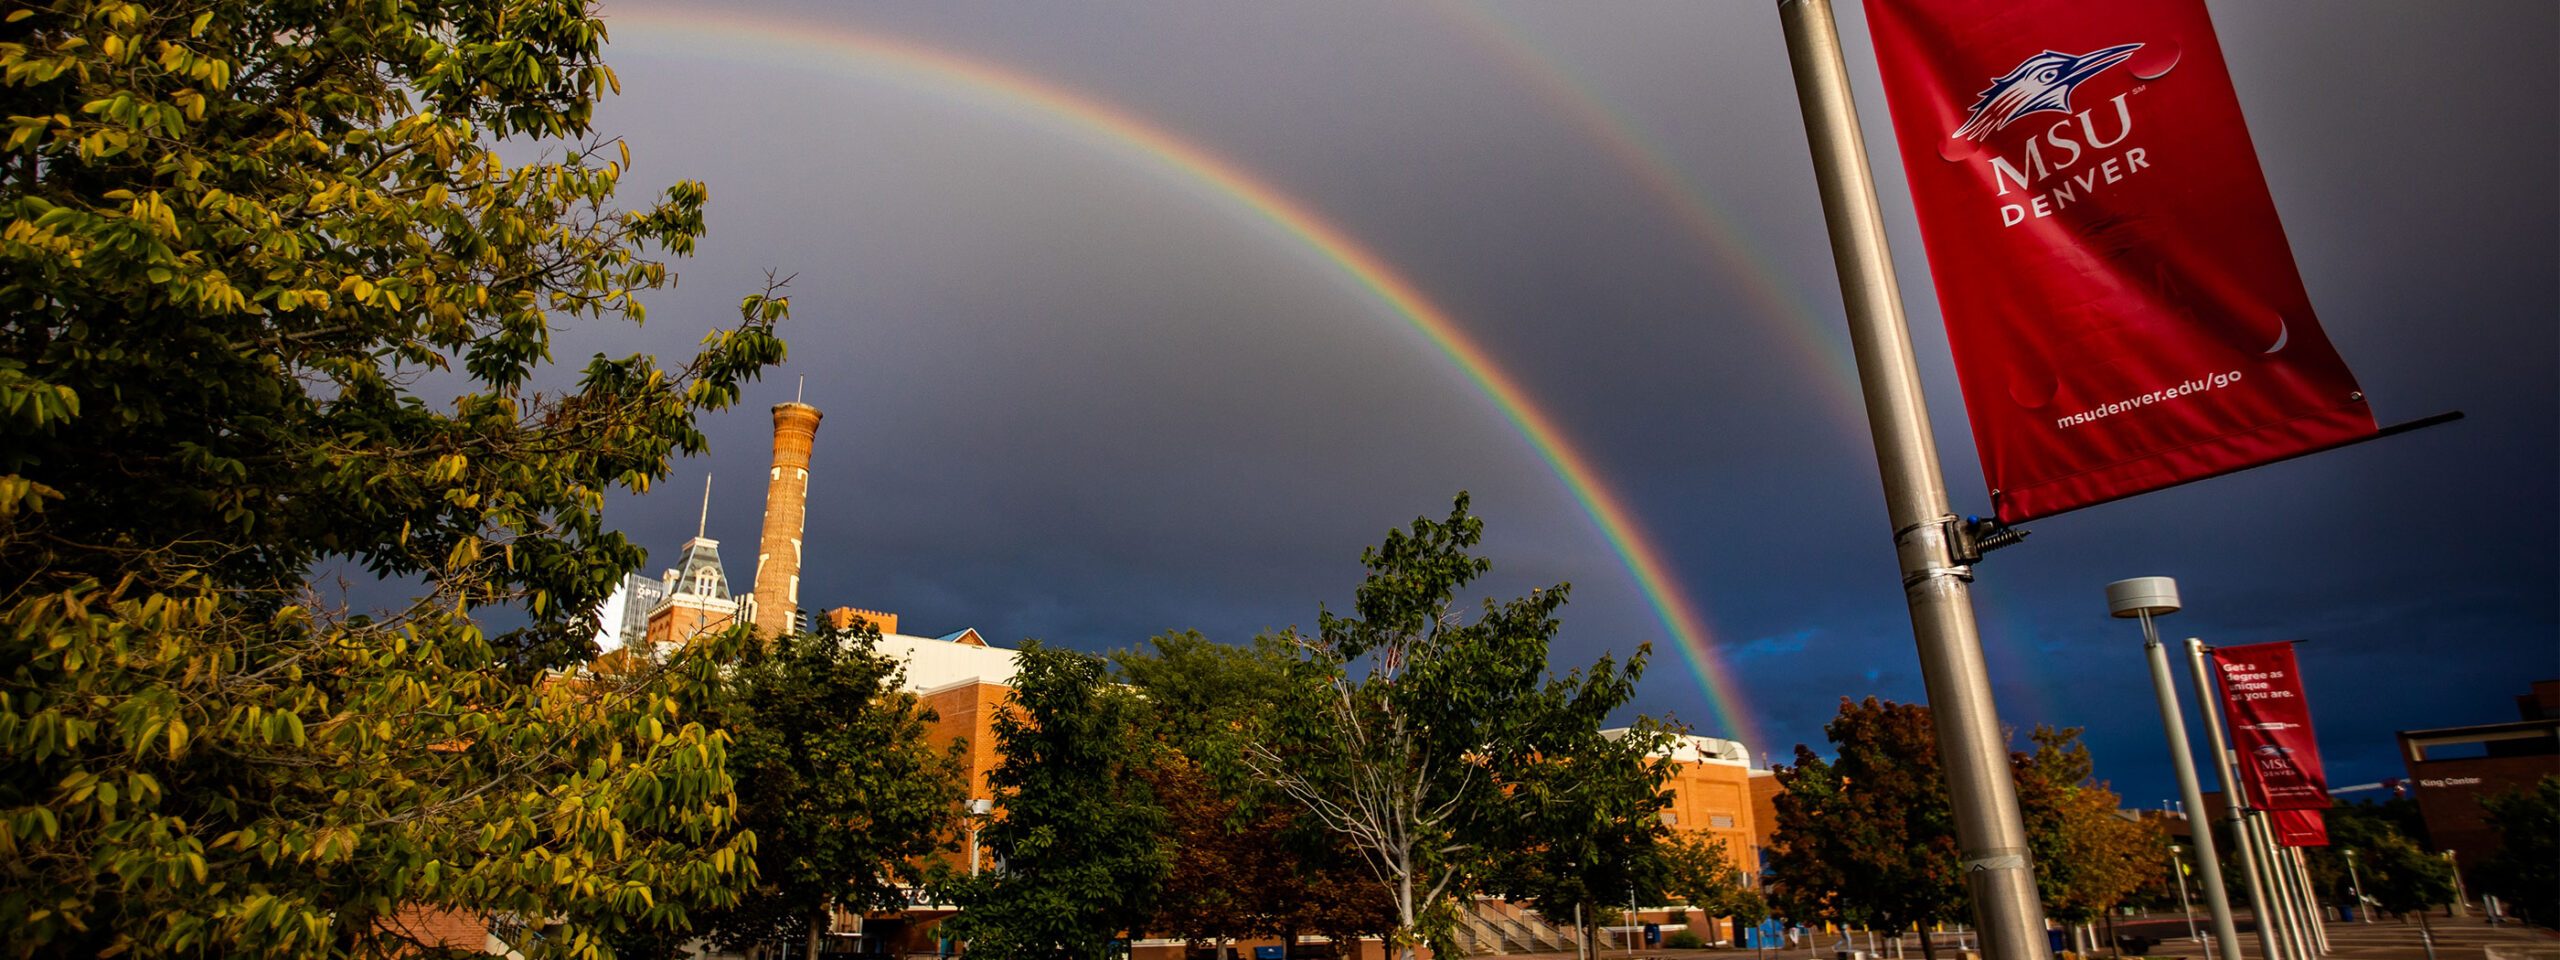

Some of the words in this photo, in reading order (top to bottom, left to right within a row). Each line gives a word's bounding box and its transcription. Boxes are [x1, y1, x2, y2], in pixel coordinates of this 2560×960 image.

[1988, 92, 2132, 196] MSU
[2000, 147, 2150, 228] DENVER
[2057, 370, 2242, 429] msudenver.edu/go
[2223, 663, 2246, 672] Get
[2247, 663, 2256, 671] a
[2226, 672, 2268, 682] degree
[2270, 670, 2284, 679] as
[2229, 681, 2270, 691] unique
[2244, 691, 2268, 702] you
[2270, 690, 2294, 699] are.
[2420, 779, 2446, 788] King
[2445, 777, 2482, 785] Center
